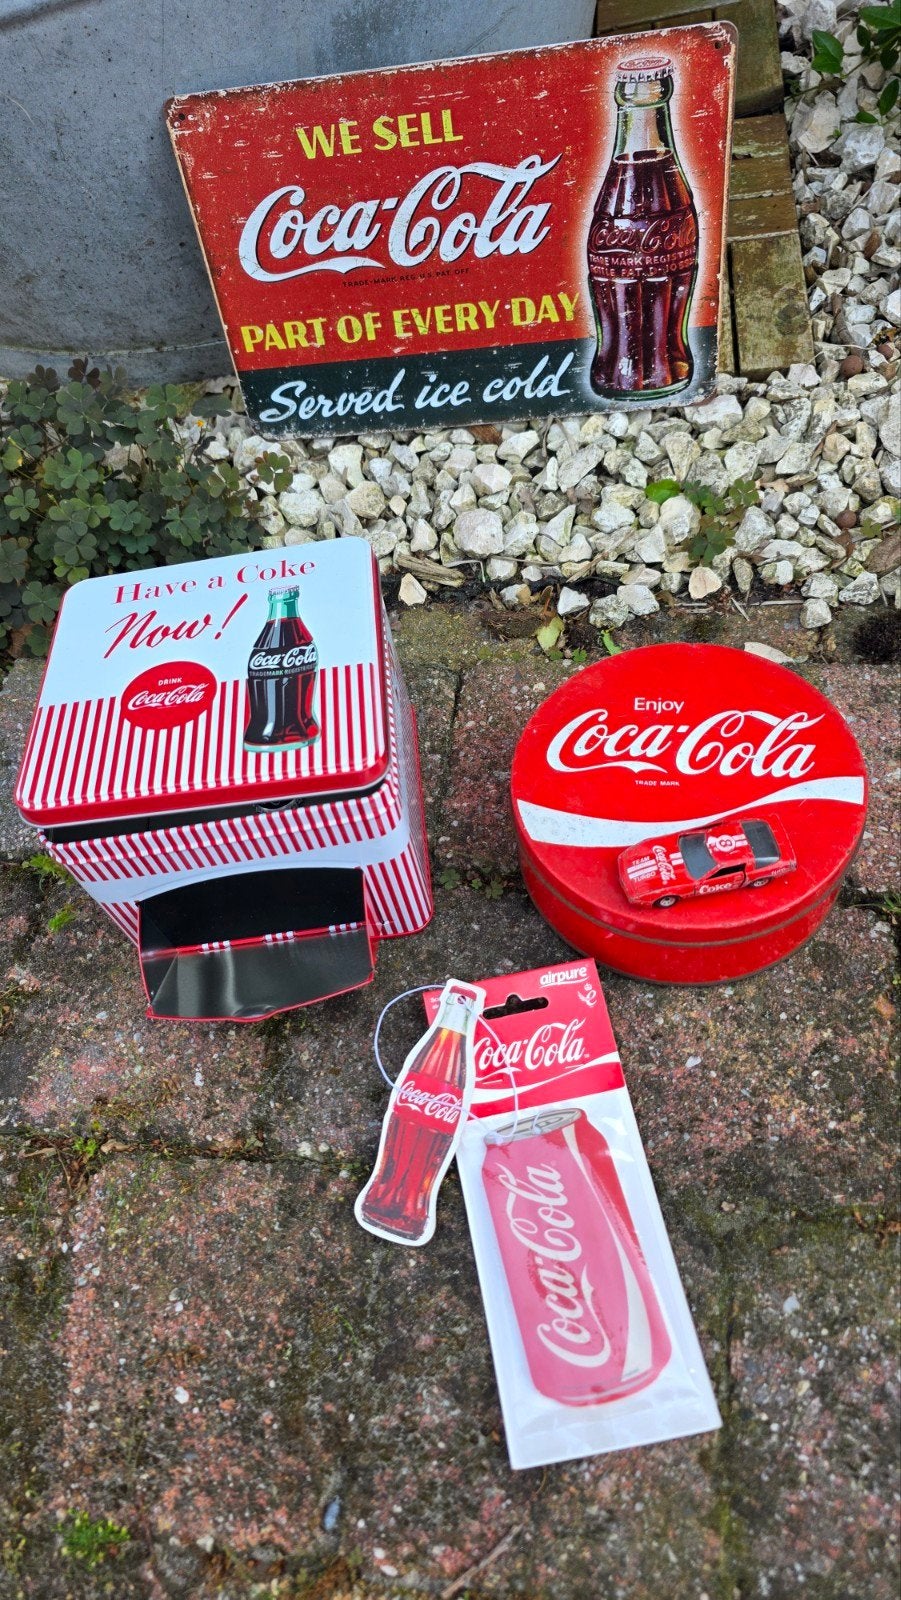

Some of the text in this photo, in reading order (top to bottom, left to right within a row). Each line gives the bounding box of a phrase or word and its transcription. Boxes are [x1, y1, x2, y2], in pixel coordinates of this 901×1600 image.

[296, 108, 464, 160] WE SELL
[238, 153, 563, 282] Coca-Cola
[612, 257, 643, 266] MARK
[240, 292, 580, 353] PART OF EVERY DAY
[258, 352, 572, 423] Served ice cold
[113, 559, 316, 605] Have a Coke
[104, 592, 249, 660] Now!
[249, 644, 317, 670] Coca-Cola
[127, 682, 210, 711] Coca-Cola
[157, 677, 183, 687] DRINK
[633, 697, 685, 714] Enjoy
[546, 708, 826, 778] Coca-Cola
[699, 882, 732, 895] Coke
[540, 966, 588, 988] airpure
[496, 1163, 611, 1368] Coca-Cola
